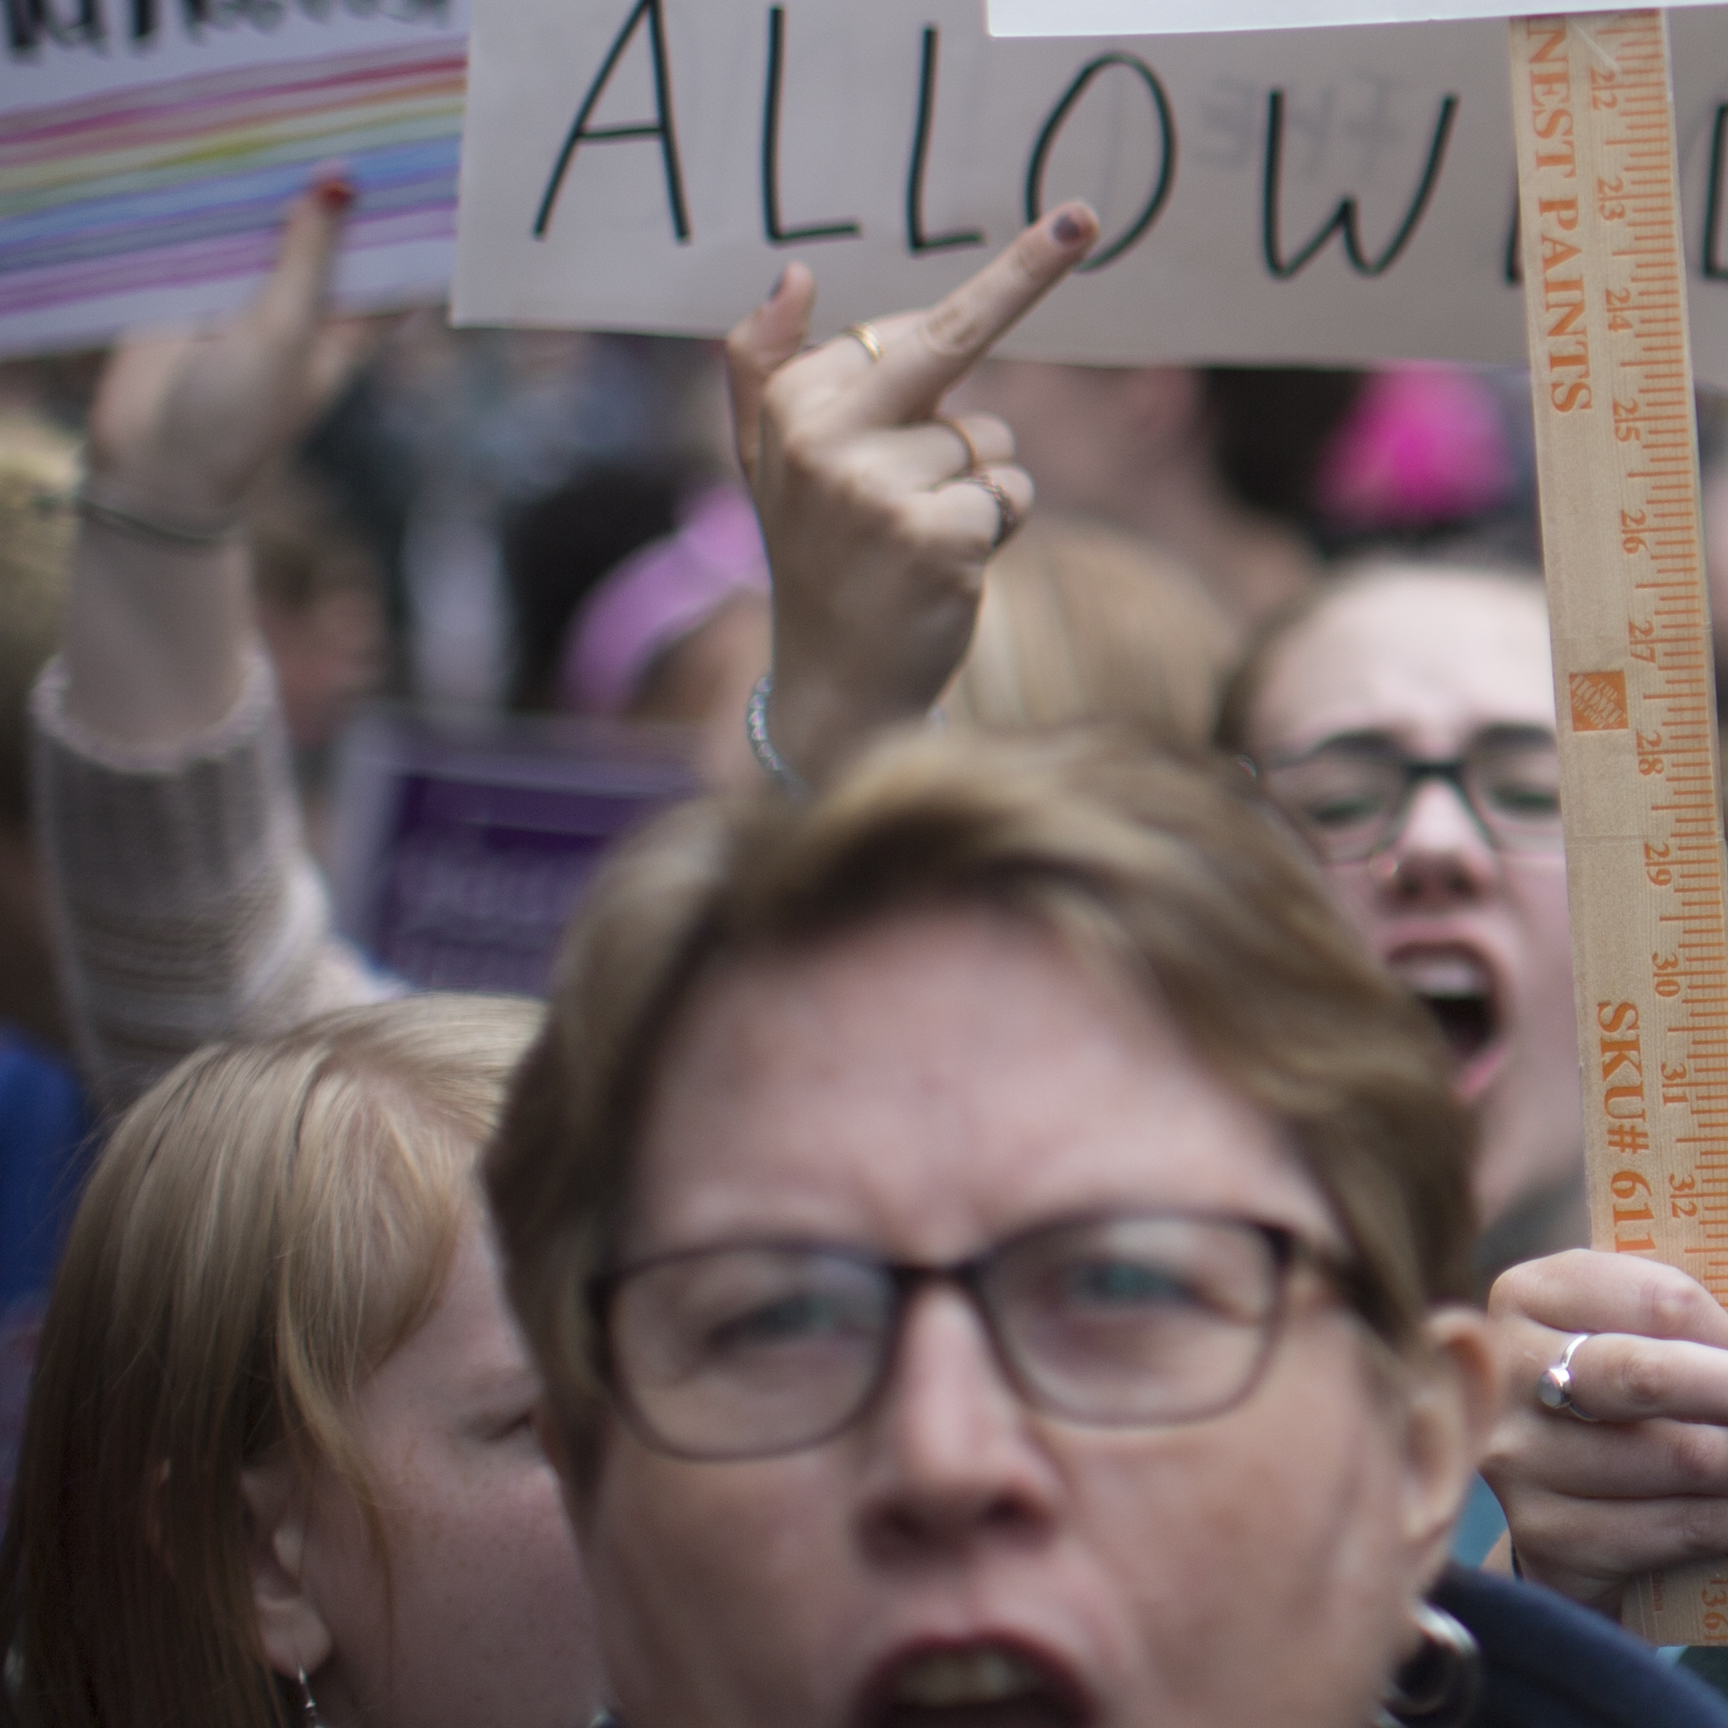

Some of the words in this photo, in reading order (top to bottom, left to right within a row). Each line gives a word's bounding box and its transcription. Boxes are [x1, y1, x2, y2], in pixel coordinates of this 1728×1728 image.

[1590, 65, 1619, 111] 22
[1597, 175, 1626, 222] 23
[1538, 194, 1593, 415] PAINTS
[1605, 286, 1634, 333] 24
[1612, 398, 1642, 444] 25
[1620, 509, 1648, 556] 26
[1628, 619, 1657, 665] 27
[1636, 731, 1665, 777] 28
[1643, 841, 1673, 888] 29
[1651, 951, 1682, 999] 30
[1597, 1000, 1651, 1156] SKU#
[1659, 1062, 1689, 1108] 31
[1668, 1173, 1698, 1220] 32
